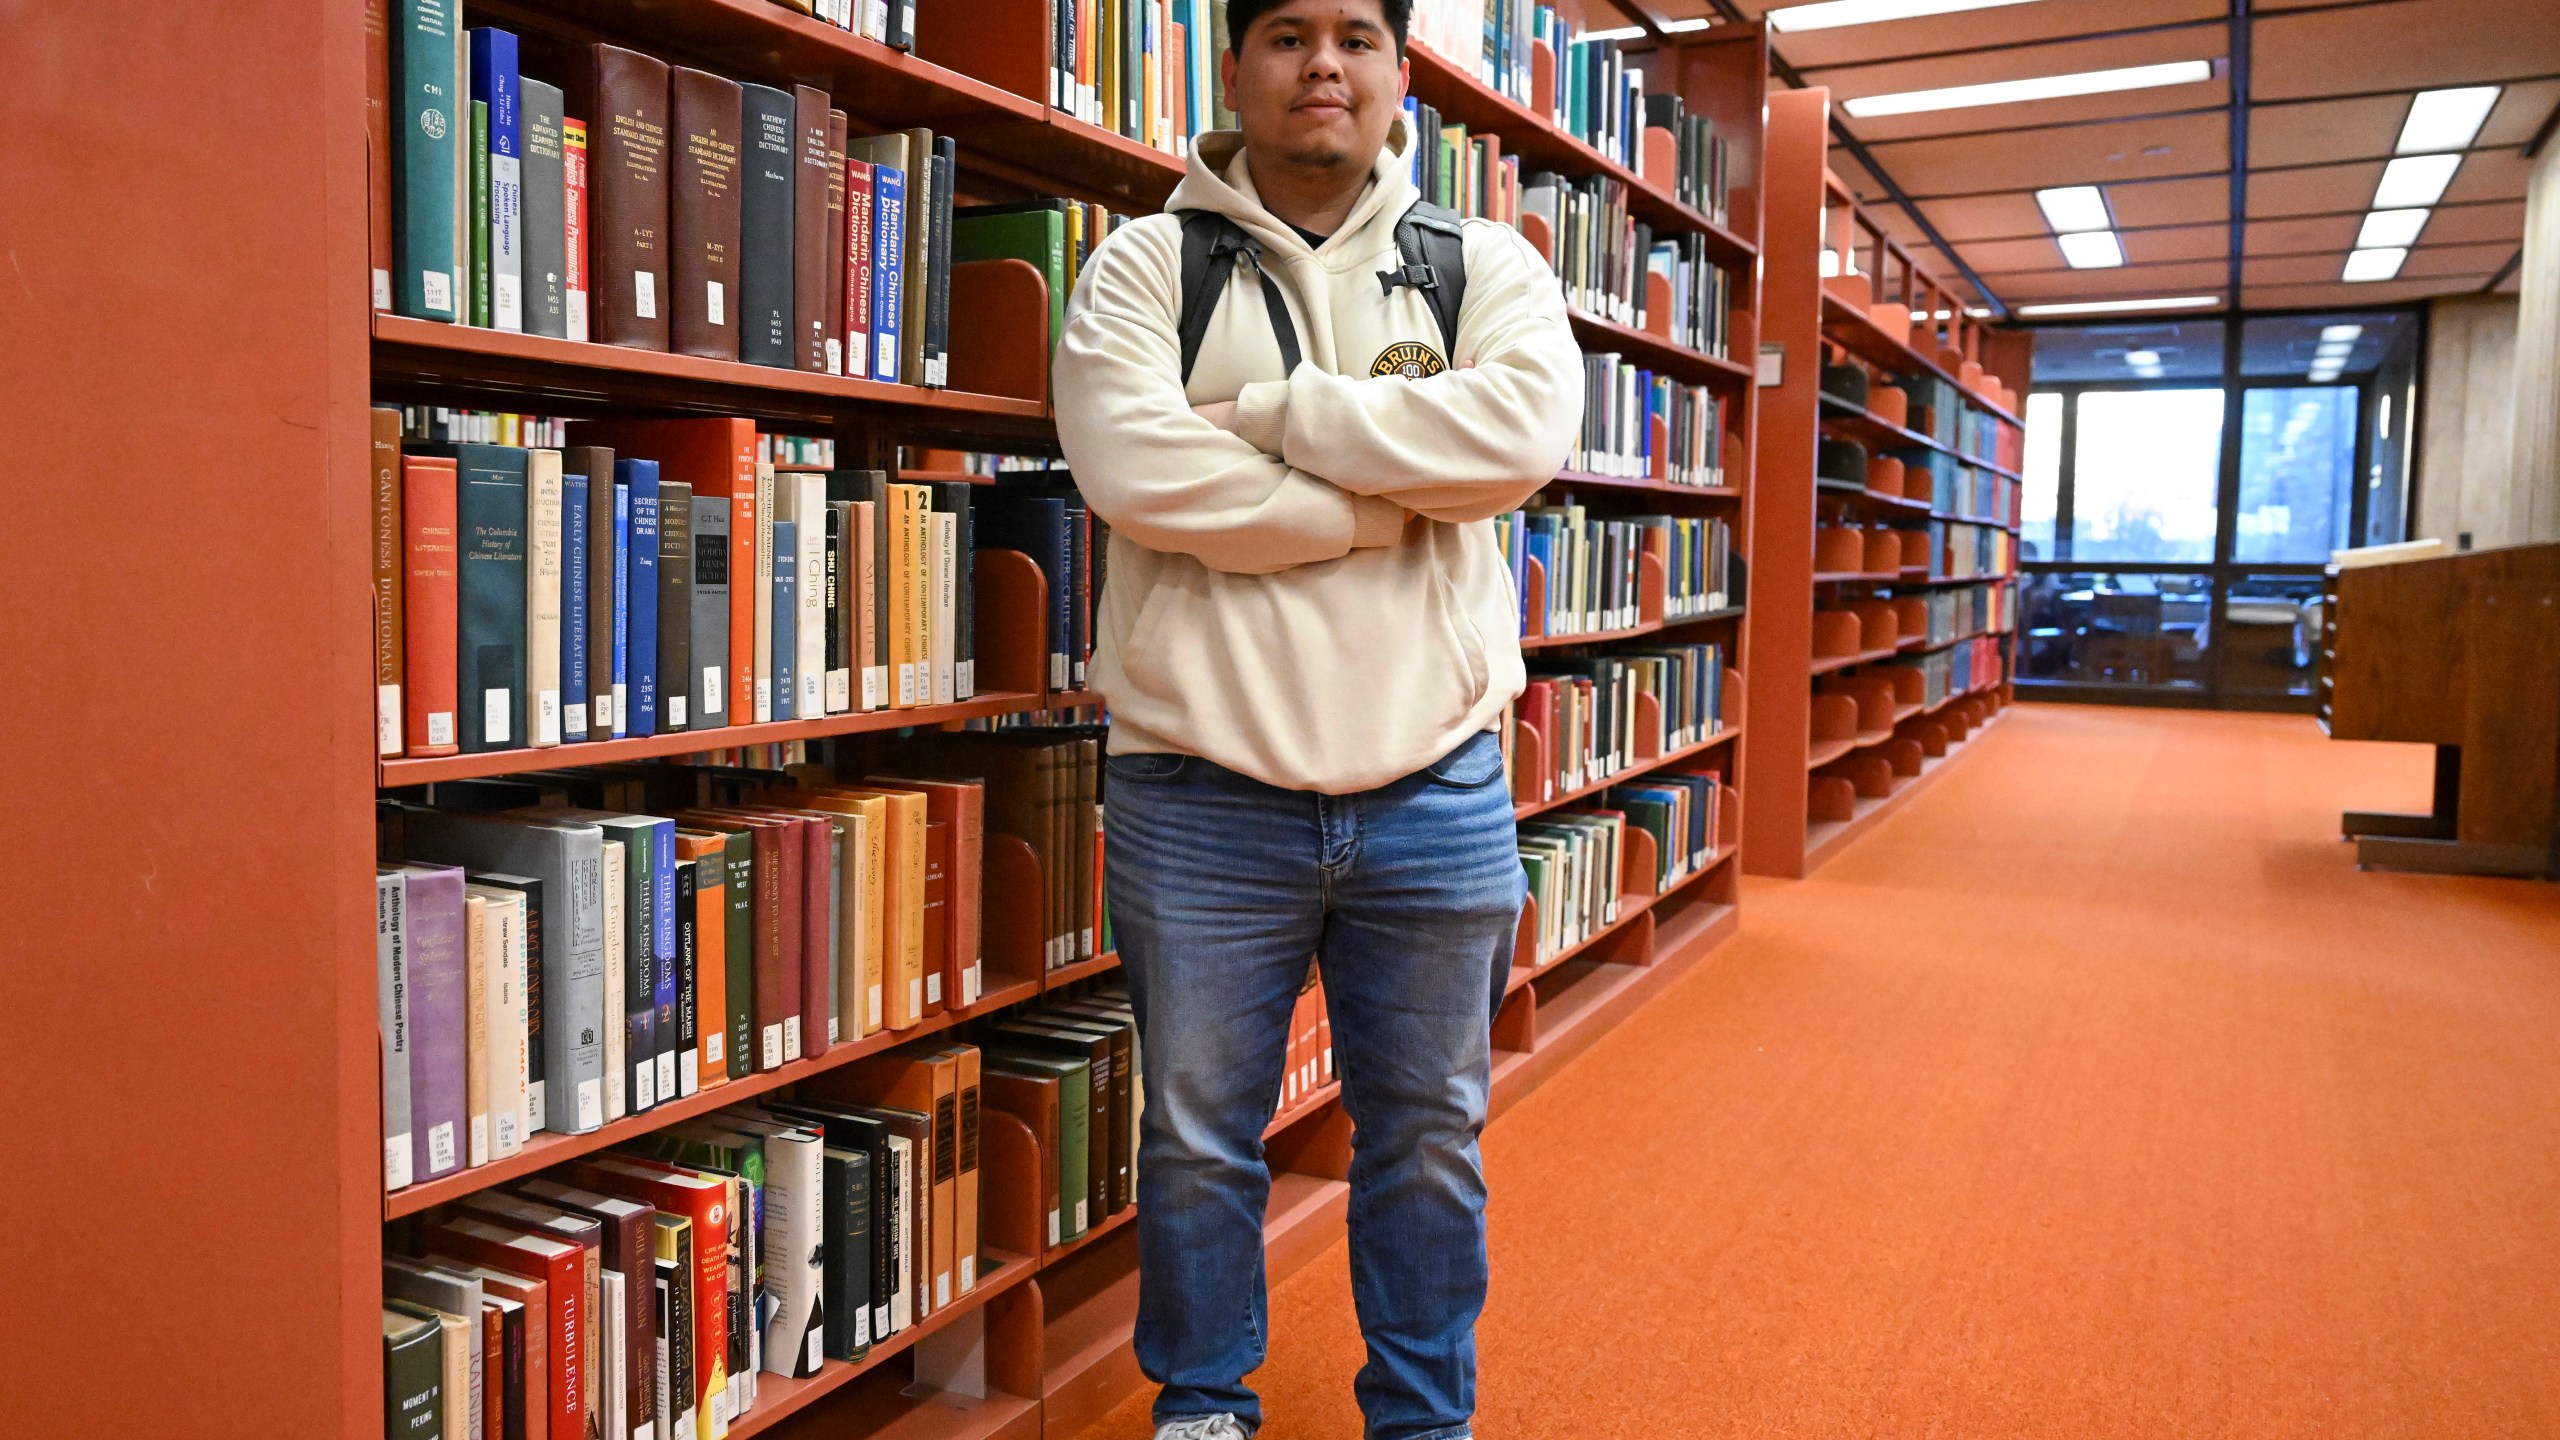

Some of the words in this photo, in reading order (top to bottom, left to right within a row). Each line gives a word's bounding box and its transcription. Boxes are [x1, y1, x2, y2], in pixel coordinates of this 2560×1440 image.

[424, 84, 442, 96] CHI
[506, 114, 512, 126] Ma
[540, 114, 551, 124] THE
[616, 115, 634, 126] ENGLISH
[636, 121, 644, 130] AND
[532, 124, 558, 138] ADVANCED
[613, 127, 638, 140] STANDARD
[764, 133, 785, 144] ENGLISH
[815, 129, 824, 137] NEW
[532, 134, 558, 148] LEARNER'S
[690, 134, 709, 146] ENGLISH
[758, 141, 788, 155] DICTIONARY
[530, 144, 560, 160] DICTIONARY
[808, 147, 825, 158] CHINESE
[804, 157, 828, 168] DICTIONARY
[851, 170, 871, 182] WANG
[881, 175, 901, 187] WANG
[493, 180, 501, 224] Processing
[849, 191, 861, 265] Dictionary
[860, 193, 871, 261] Mandarin
[879, 194, 891, 270] Dictionary
[889, 199, 900, 267] Mandarin
[502, 215, 510, 256] Language
[859, 266, 870, 324] Chinese
[888, 271, 899, 329] Chinese
[1378, 346, 1440, 375] BRUINS
[1402, 364, 1420, 377] 100
[634, 497, 657, 506] SECRETS
[904, 490, 909, 510] 1
[918, 491, 927, 510] 2
[380, 468, 392, 569] CANTONESE
[574, 504, 582, 542] EARLY
[904, 515, 910, 524] AN
[920, 514, 926, 523] AN
[476, 527, 487, 536] The
[488, 527, 518, 537] Columbia
[766, 521, 772, 534] ON
[943, 520, 951, 548] Anthology
[482, 539, 504, 549] History
[504, 540, 512, 549] of
[469, 552, 492, 560] Chinese
[494, 552, 522, 561] Literature
[573, 547, 582, 602] CHINESE
[904, 570, 910, 579] OF
[921, 569, 926, 577] OF
[806, 560, 821, 608] Ching
[827, 576, 835, 608] CHING
[381, 578, 392, 682] DICTIONARY
[574, 606, 582, 686] LITERATURE
[609, 858, 620, 902] Three
[391, 886, 400, 932] Anthology
[772, 904, 779, 916] TO
[392, 935, 400, 944] of
[608, 904, 620, 977] Kingdoms
[392, 946, 402, 981] Modern
[527, 957, 538, 970] OF
[684, 969, 691, 982] OF
[394, 984, 402, 1020] Chinese
[520, 1009, 526, 1025] OF
[394, 1022, 404, 1052] Poetry
[634, 1223, 645, 1256] SOUL
[702, 1256, 719, 1264] DEATH
[716, 1270, 725, 1278] OUT
[636, 1259, 647, 1329] MOUNTAIN
[564, 1294, 577, 1414] TURBULENCE
[403, 1390, 429, 1410] MOMENT
[411, 1410, 432, 1429] PEKING
